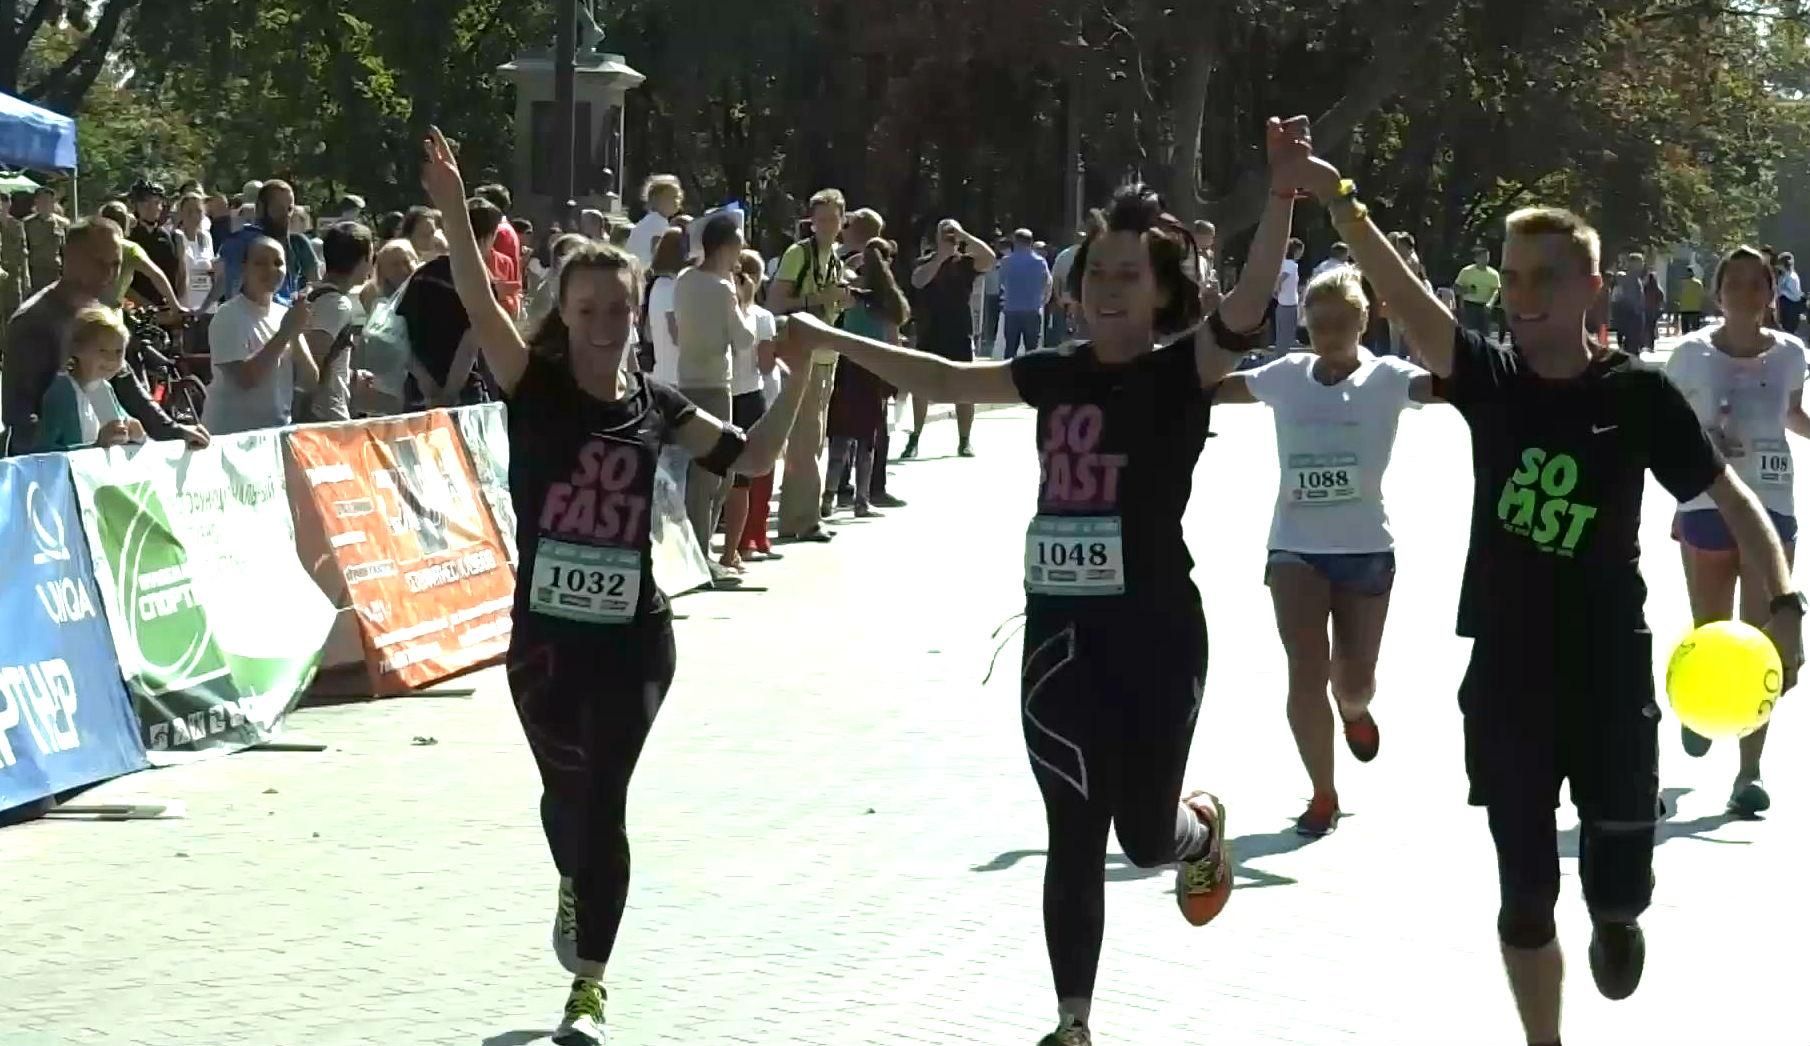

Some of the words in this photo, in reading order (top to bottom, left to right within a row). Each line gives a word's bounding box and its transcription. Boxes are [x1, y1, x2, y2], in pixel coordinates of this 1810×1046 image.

[1042, 404, 1104, 452] SO
[571, 439, 638, 491] SO
[1297, 470, 1349, 490] 1088
[1513, 447, 1578, 496] SO
[538, 482, 646, 543] FAST
[1037, 541, 1108, 566] 1048
[549, 565, 626, 597] 1032
